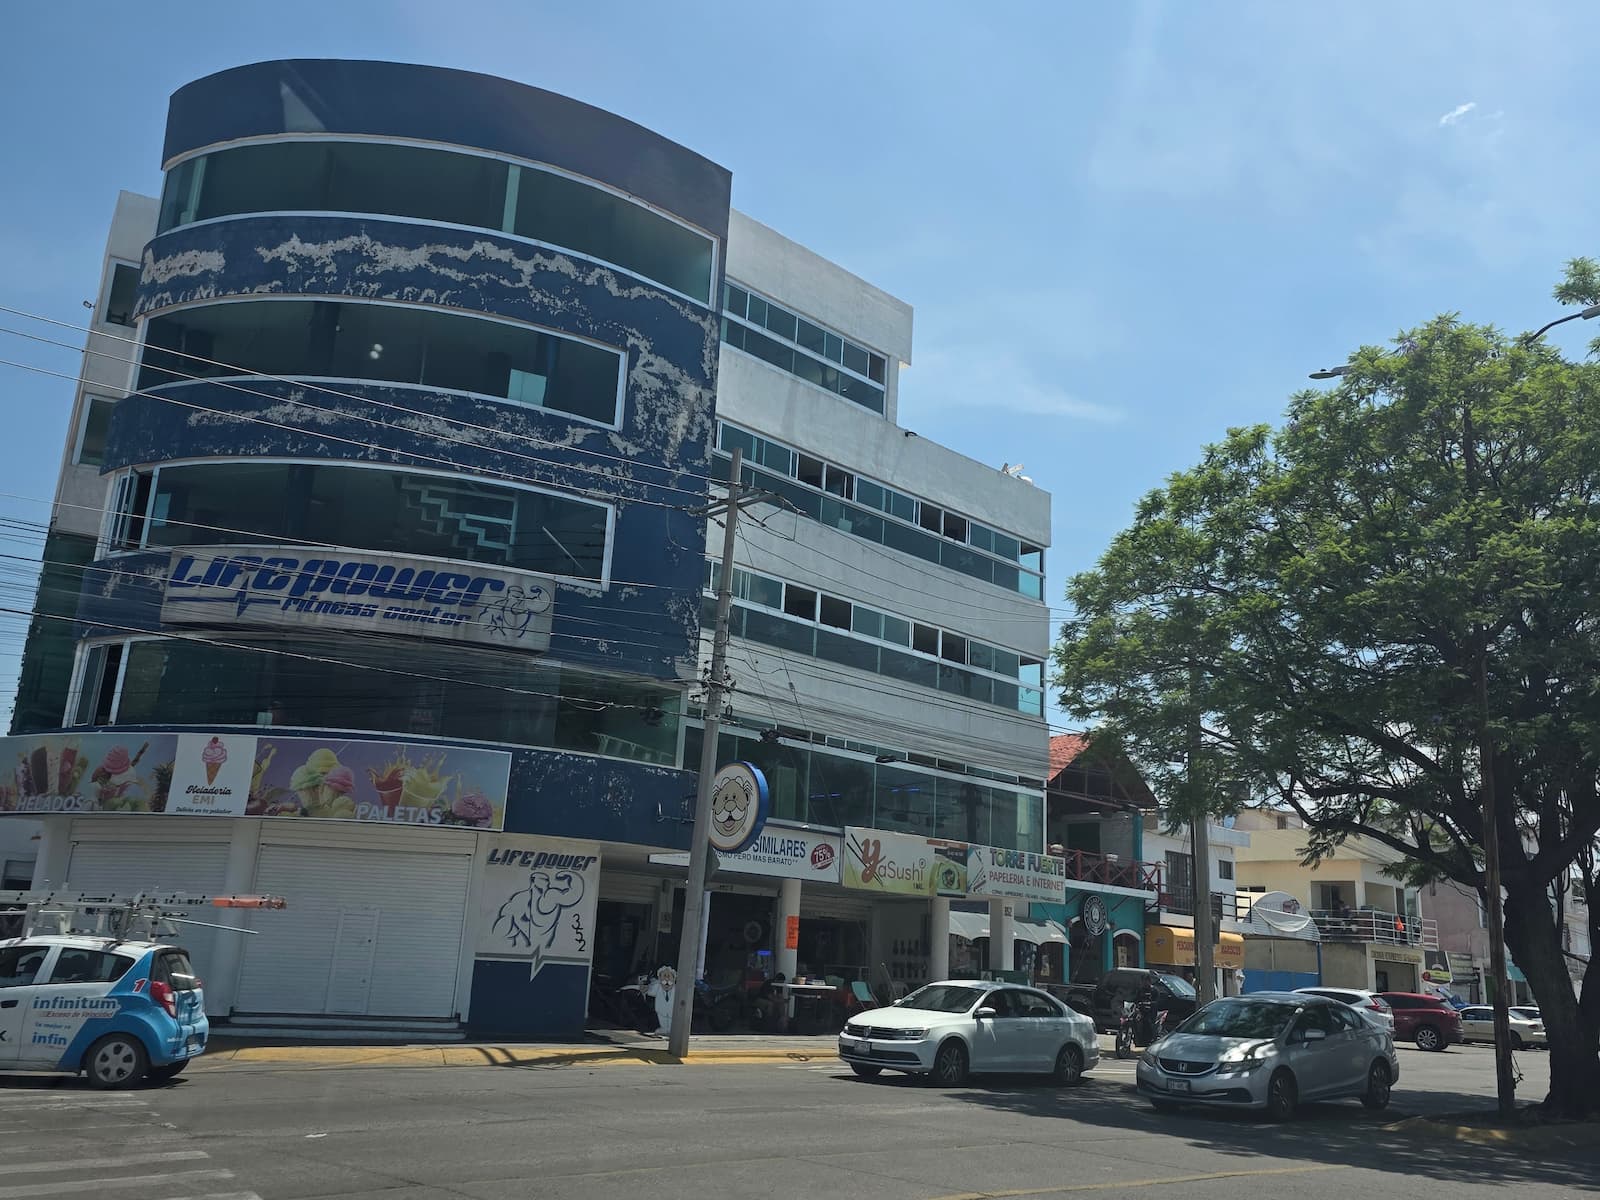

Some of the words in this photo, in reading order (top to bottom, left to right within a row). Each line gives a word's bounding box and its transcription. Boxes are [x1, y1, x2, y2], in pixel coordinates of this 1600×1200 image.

[16, 796, 84, 811] HELADOS
[192, 795, 215, 805] EMI
[355, 803, 443, 824] PALETAS
[752, 836, 807, 858] SIMILARES
[989, 848, 1025, 870] TORRE
[1028, 853, 1065, 876] FUERTE
[989, 870, 1025, 886] PAPELERIA
[1026, 878, 1031, 886] E
[1032, 879, 1065, 891] INTERNET
[133, 978, 148, 993] 1
[33, 995, 117, 1010] infinitum
[32, 1032, 67, 1046] infin
